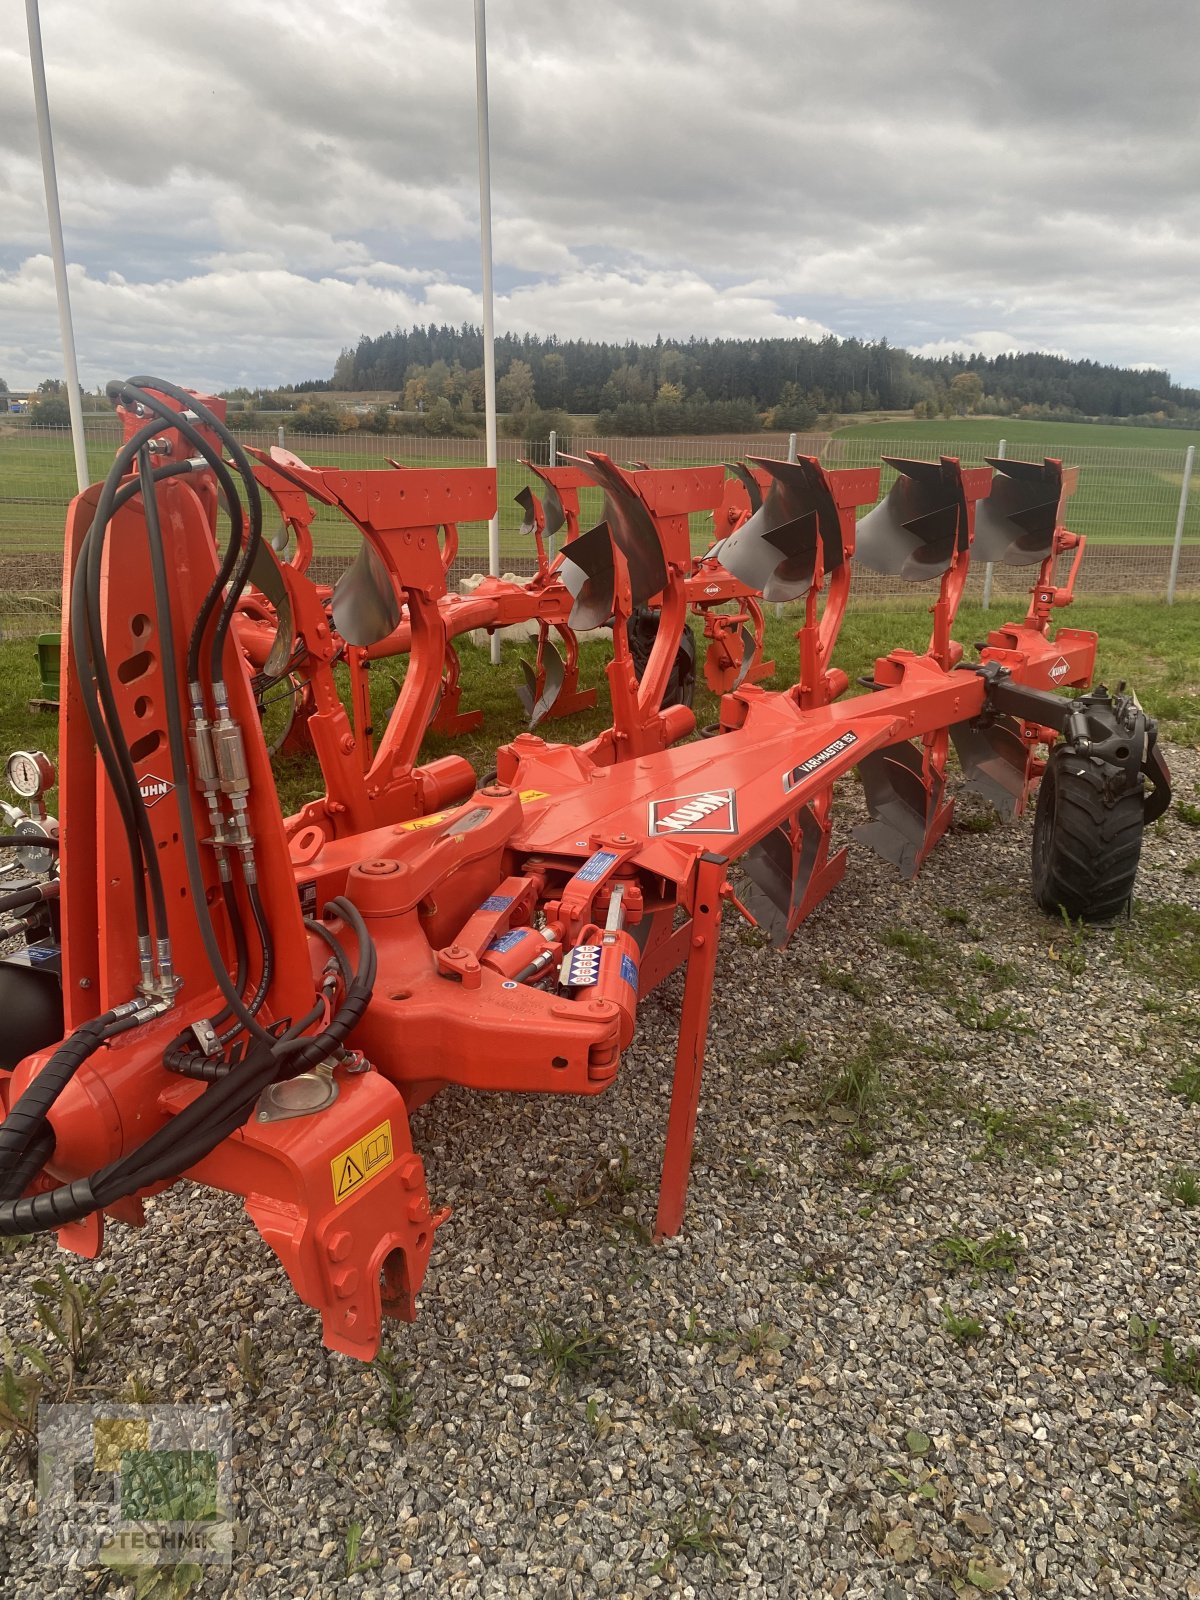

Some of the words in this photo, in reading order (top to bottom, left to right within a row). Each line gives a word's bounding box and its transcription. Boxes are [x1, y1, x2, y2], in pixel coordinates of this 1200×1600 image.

[1051, 665, 1067, 677] KUHN
[798, 740, 848, 773] VARI-MASTER
[139, 782, 168, 798] UHN
[655, 793, 732, 830] KUHN
